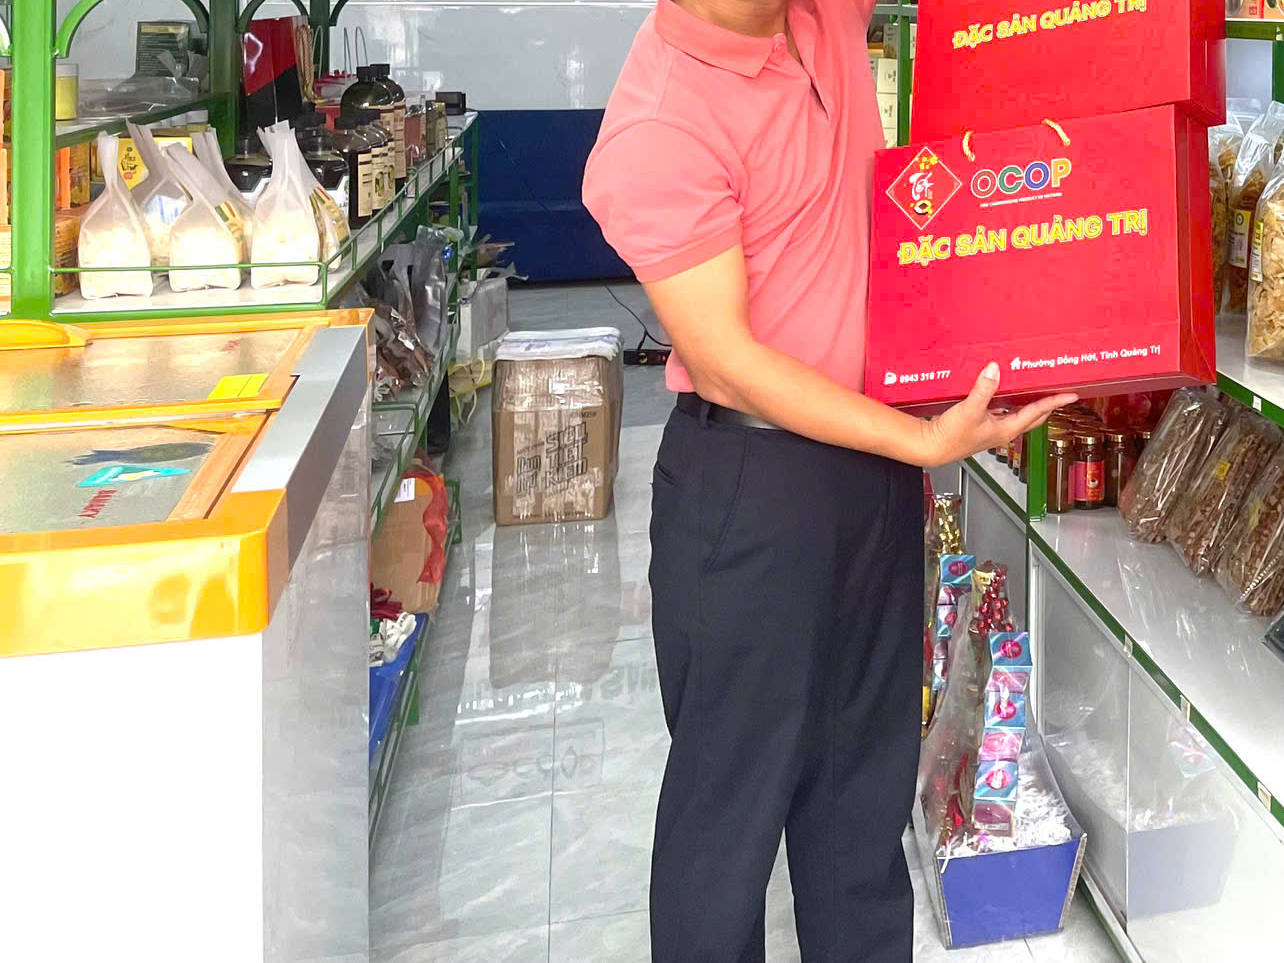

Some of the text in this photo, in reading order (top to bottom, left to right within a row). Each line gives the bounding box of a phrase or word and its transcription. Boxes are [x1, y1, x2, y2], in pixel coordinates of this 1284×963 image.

[952, 23, 994, 49] ĐẶC
[996, 13, 1038, 39] SẢN
[1039, 0, 1112, 30] QUẢNG
[971, 157, 1072, 199] OCOP
[897, 208, 1148, 267] ĐẶC SẢN QUẢNG TRỊ
[936, 370, 951, 380] 777
[1022, 357, 1055, 370] Phường
[1057, 353, 1079, 366] Đồng
[1120, 346, 1148, 360] Quảng
[1149, 345, 1160, 356] Trị
